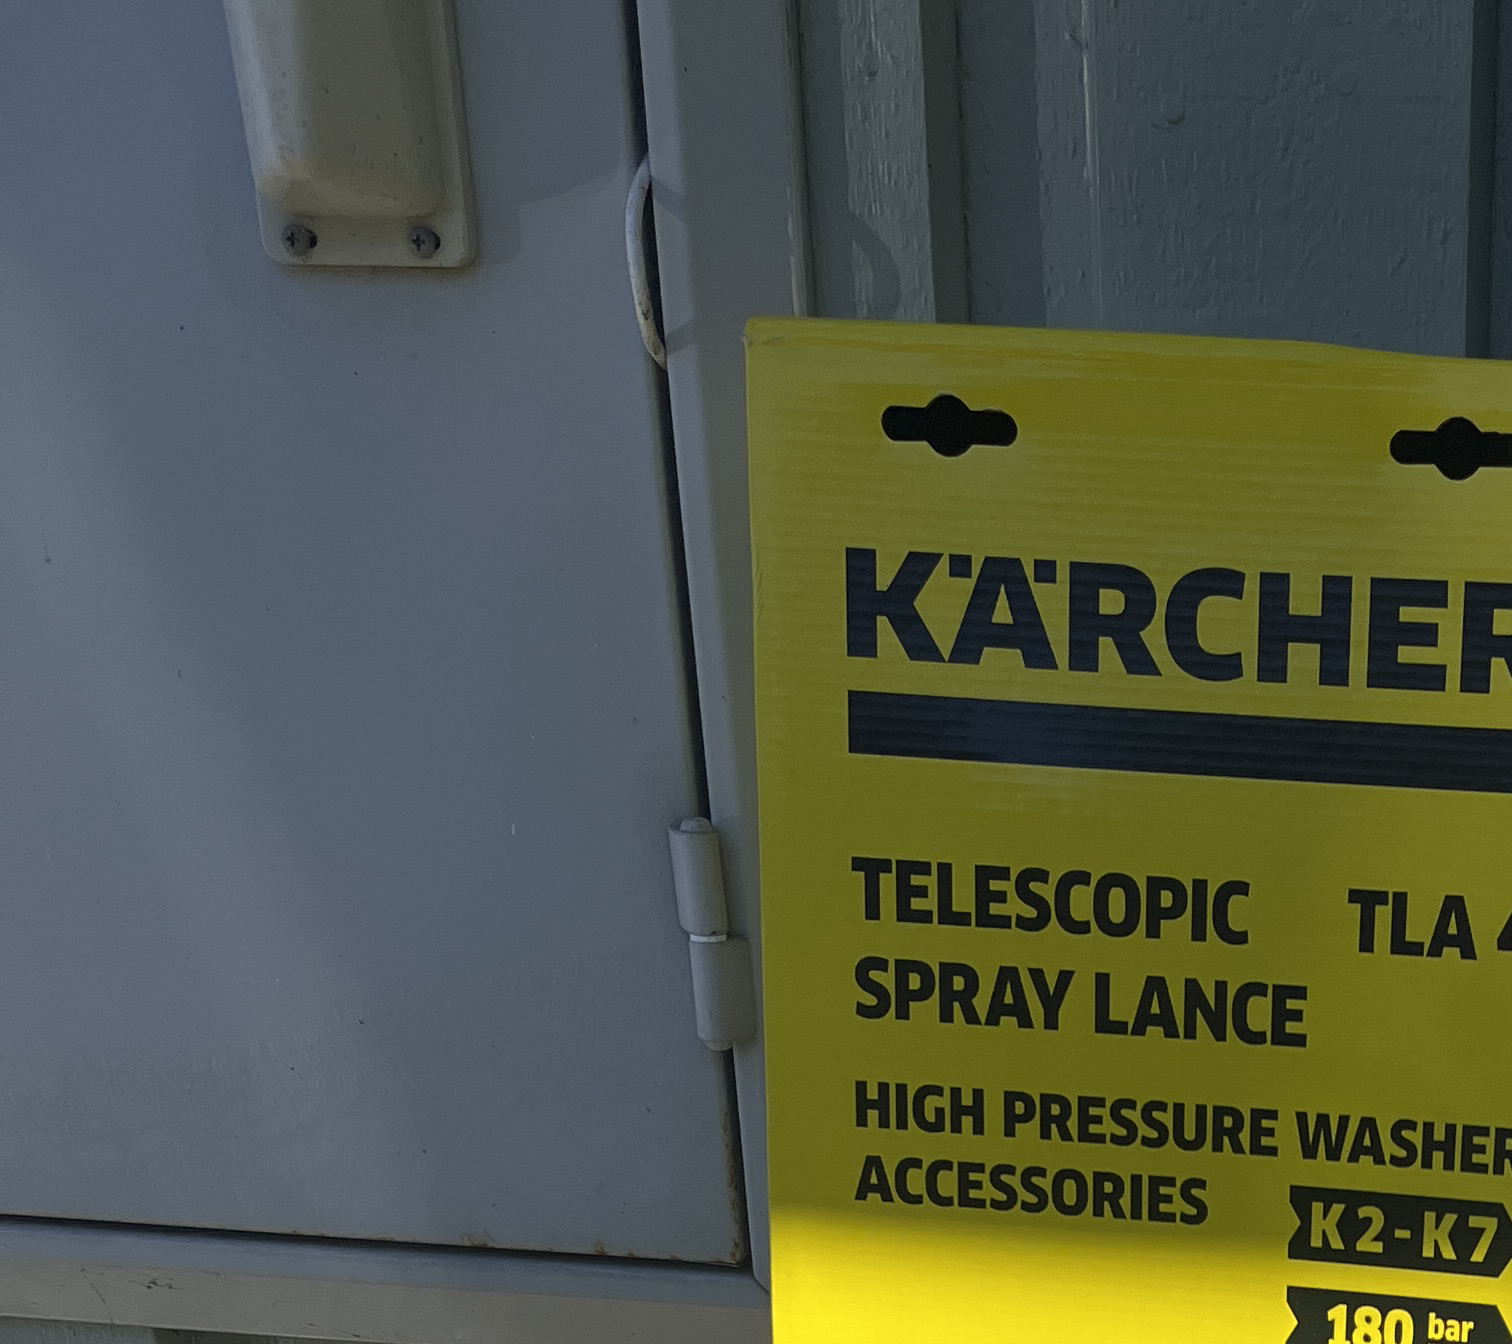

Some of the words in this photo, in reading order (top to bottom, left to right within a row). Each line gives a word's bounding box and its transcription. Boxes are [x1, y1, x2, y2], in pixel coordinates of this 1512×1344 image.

[851, 856, 1251, 946] TELESCOPIC
[1347, 887, 1478, 961] TLA
[854, 955, 1076, 1031] SPRAY
[1094, 971, 1308, 1049] LANCE
[854, 1079, 985, 1137] HIGH
[1003, 1090, 1279, 1158] PRESSURE
[854, 1154, 1209, 1226] ACCESSORIES
[1427, 1312, 1475, 1343] bar
